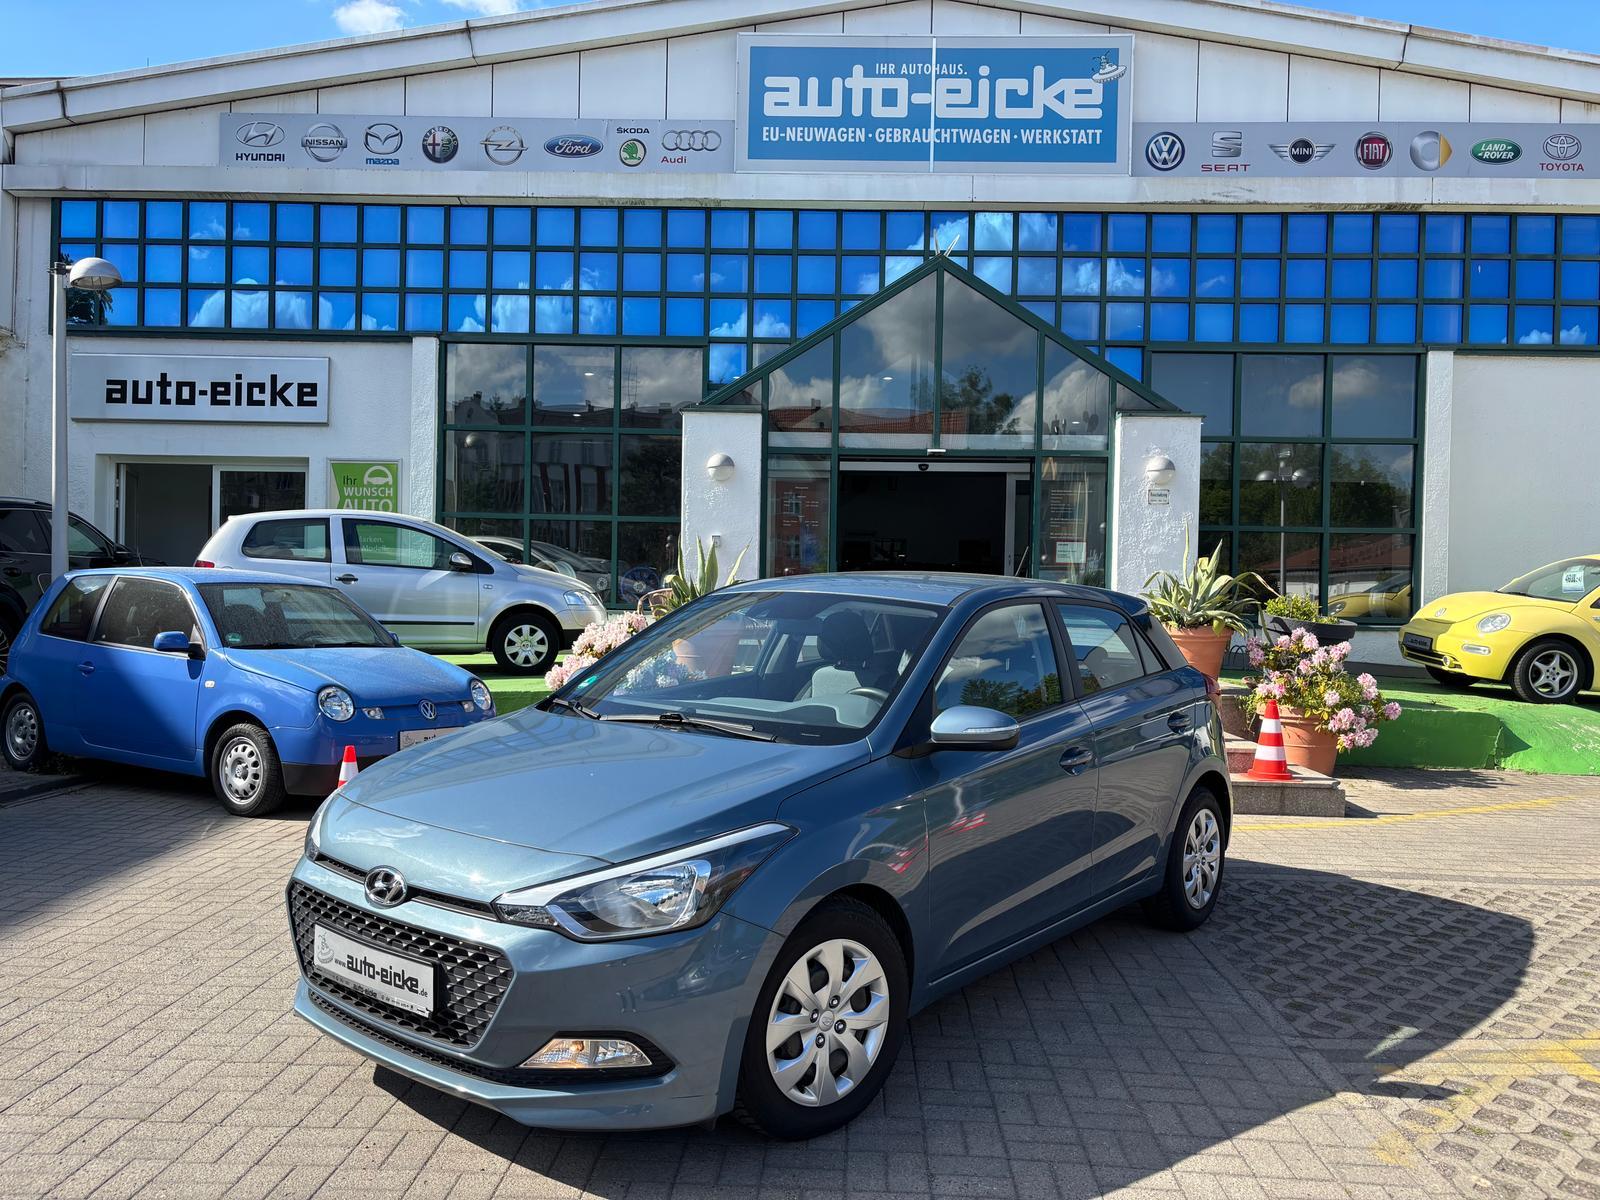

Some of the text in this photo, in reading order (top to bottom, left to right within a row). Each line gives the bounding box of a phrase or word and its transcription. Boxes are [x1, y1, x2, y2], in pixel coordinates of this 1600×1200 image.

[875, 63, 896, 76] IHR
[763, 64, 1103, 120] auto-eicke
[616, 126, 650, 134] ŠKODA
[762, 126, 1103, 146] EU-NEUWAGEN GEBRAUCHTWAGEN WERKSTATT
[305, 138, 344, 147] NISSAN
[554, 137, 592, 154] Ford
[1480, 142, 1505, 151] LAND
[1291, 147, 1313, 156] MINI
[1363, 142, 1385, 160] FIAT
[1483, 150, 1515, 160] ROVER
[235, 152, 285, 162] HYUNDAI
[365, 157, 400, 166] mazda
[660, 155, 687, 164] Audi
[1200, 163, 1250, 172] SEAT
[1538, 162, 1585, 172] TOYOTA
[105, 372, 318, 407] auto-eicke
[343, 474, 357, 486] Ihr
[343, 486, 393, 497] WUNSCH
